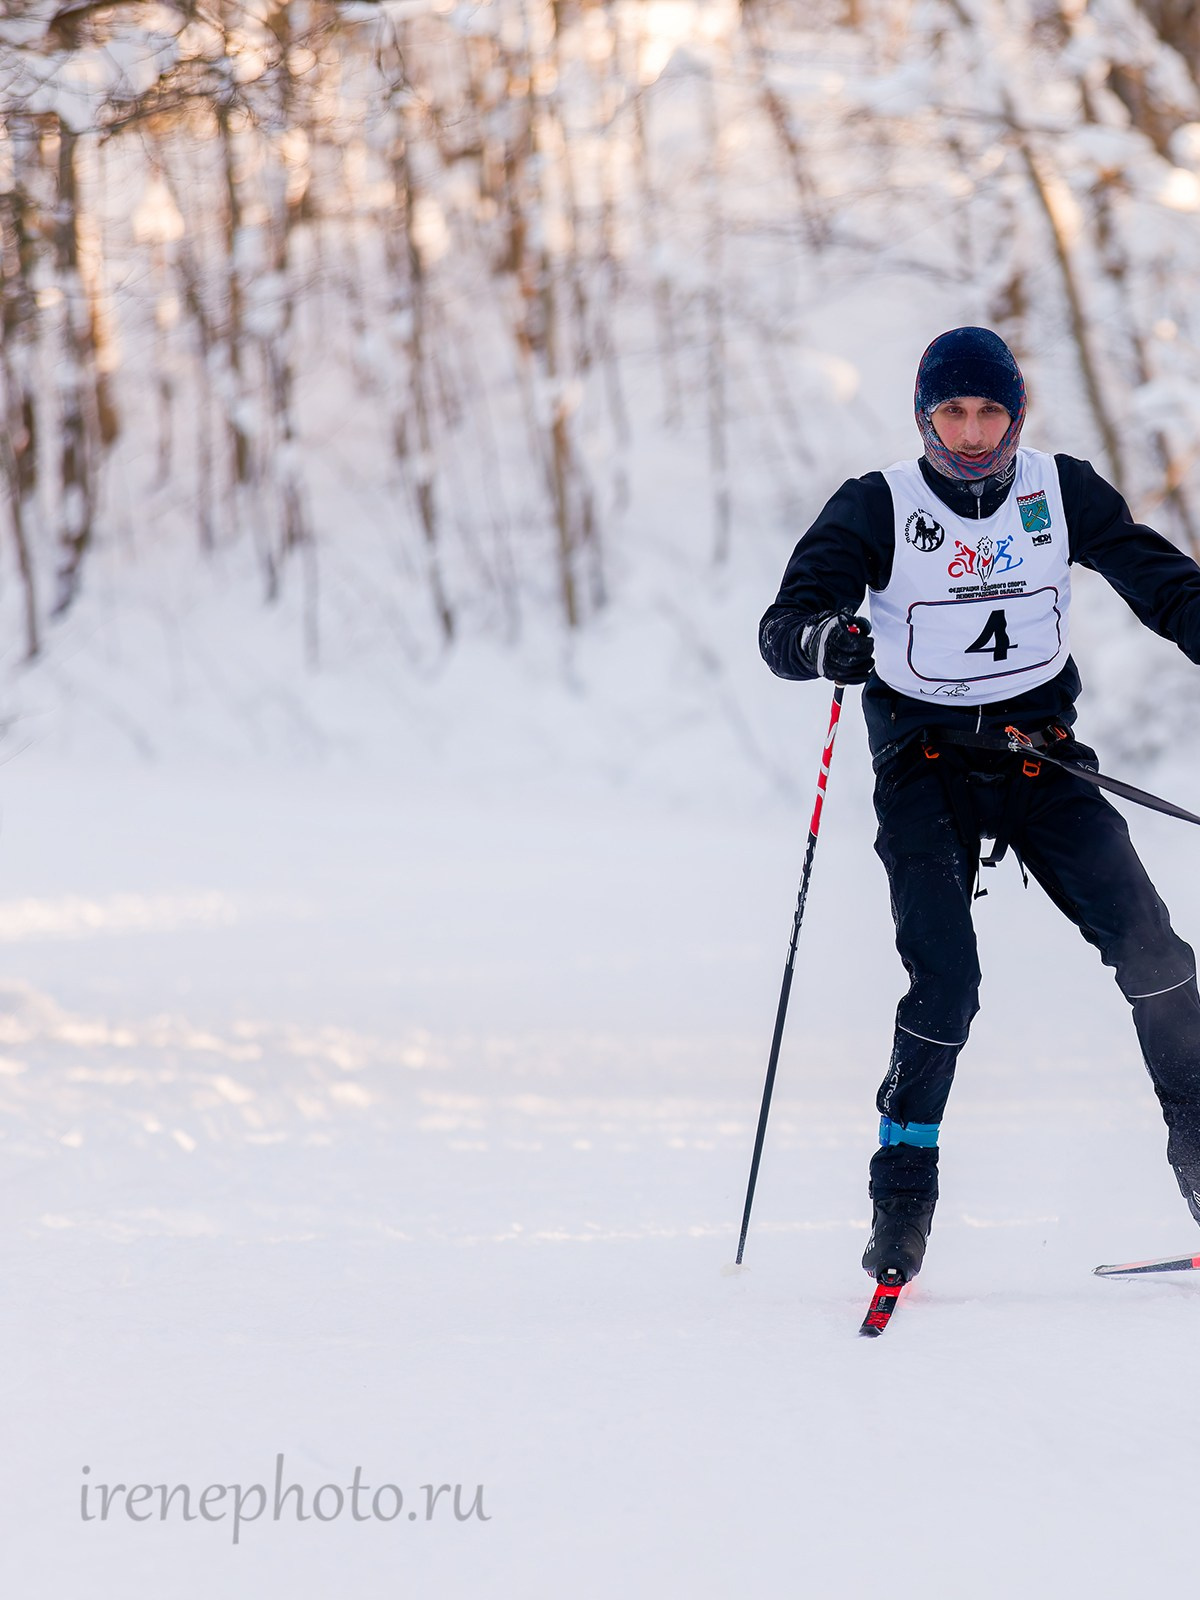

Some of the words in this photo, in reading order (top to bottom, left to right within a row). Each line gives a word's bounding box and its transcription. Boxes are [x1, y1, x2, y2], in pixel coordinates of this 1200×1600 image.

[904, 511, 919, 544] moondog
[948, 585, 980, 593] ФЕДЕРАЦИЯ
[1007, 580, 1027, 588] СПОРТА
[999, 587, 1023, 595] ОБЛАСТИ
[964, 609, 1018, 662] 4
